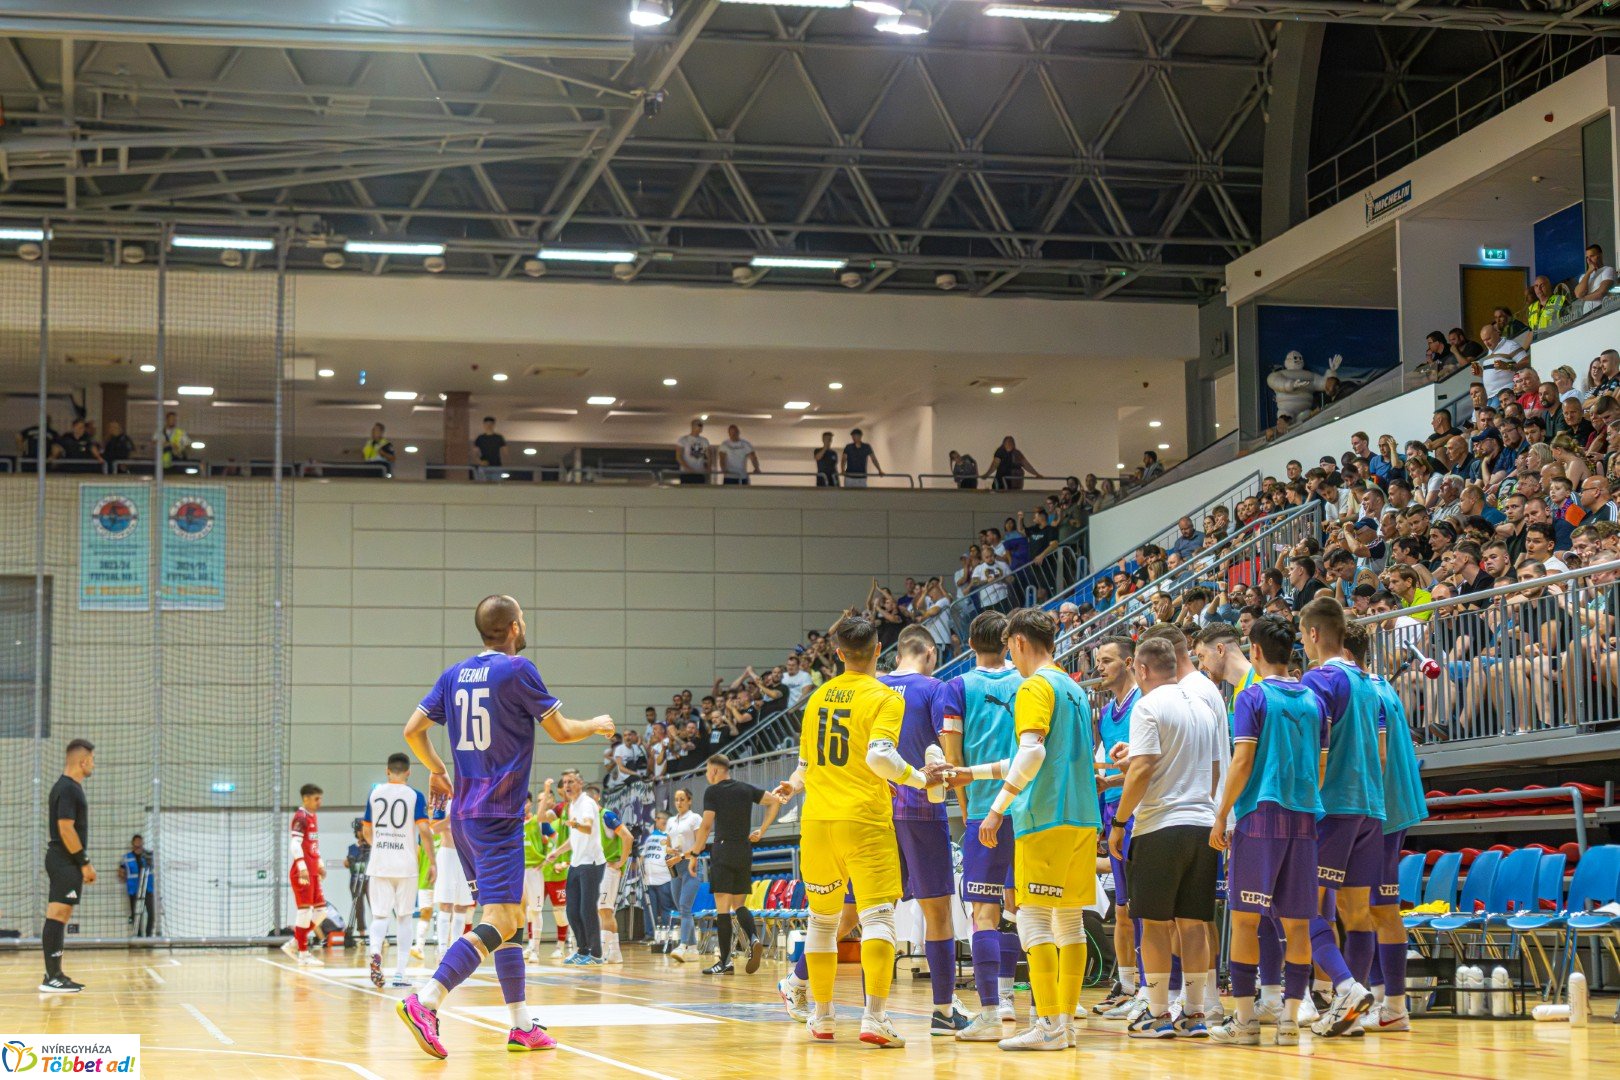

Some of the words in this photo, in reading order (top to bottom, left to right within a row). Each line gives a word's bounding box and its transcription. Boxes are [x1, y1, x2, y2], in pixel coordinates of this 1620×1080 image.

[1374, 185, 1410, 213] MICHELIN
[824, 687, 855, 703] GÉMESI
[455, 688, 491, 751] 25
[817, 707, 851, 767] 15
[374, 797, 408, 829] 20
